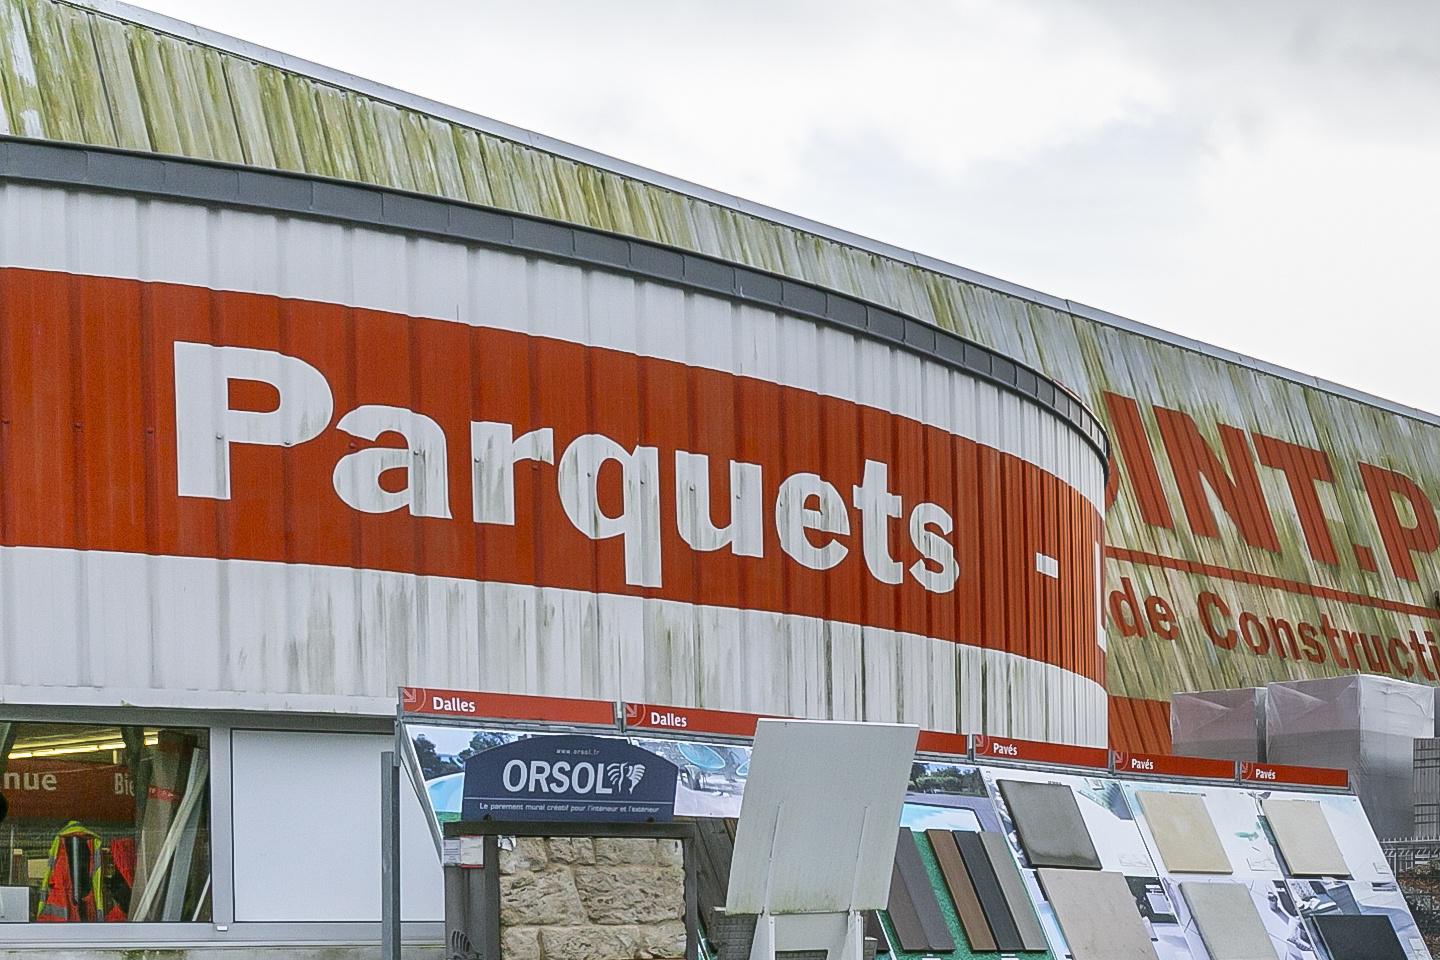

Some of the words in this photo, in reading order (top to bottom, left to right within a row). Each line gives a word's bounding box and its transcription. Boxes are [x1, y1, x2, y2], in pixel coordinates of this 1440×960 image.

[173, 340, 961, 595] Parquets
[1109, 576, 1179, 642] de
[432, 695, 476, 714] Dalles
[650, 711, 688, 729] Dalles
[993, 741, 1018, 757] Pavés
[1130, 758, 1155, 773] Pavés
[502, 758, 614, 795] ORSOL
[1255, 768, 1277, 782] Pavés
[479, 802, 488, 810] Le
[490, 803, 524, 812] parement
[525, 804, 545, 812] mural
[570, 805, 586, 813] pour
